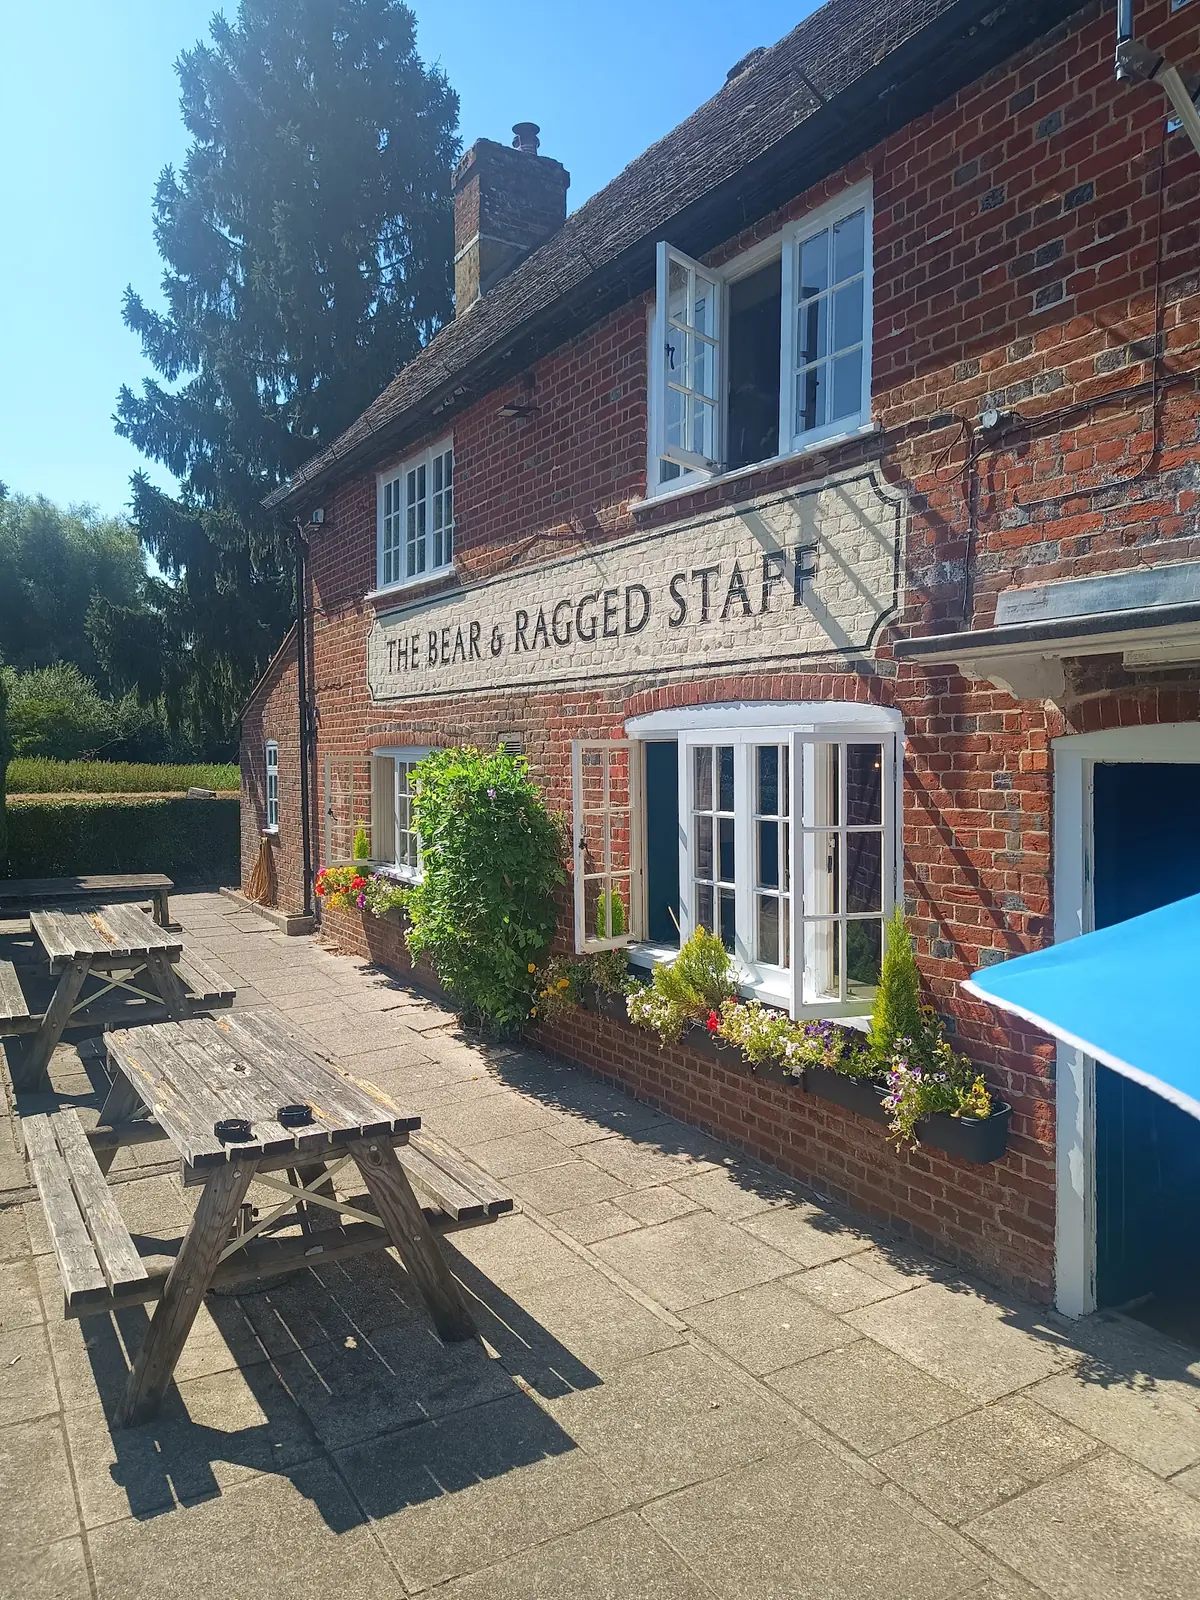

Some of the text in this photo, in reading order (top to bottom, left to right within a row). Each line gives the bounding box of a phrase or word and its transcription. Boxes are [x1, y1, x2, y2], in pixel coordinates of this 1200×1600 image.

[387, 540, 820, 672] THE BEAR & RAGGED STAFF
